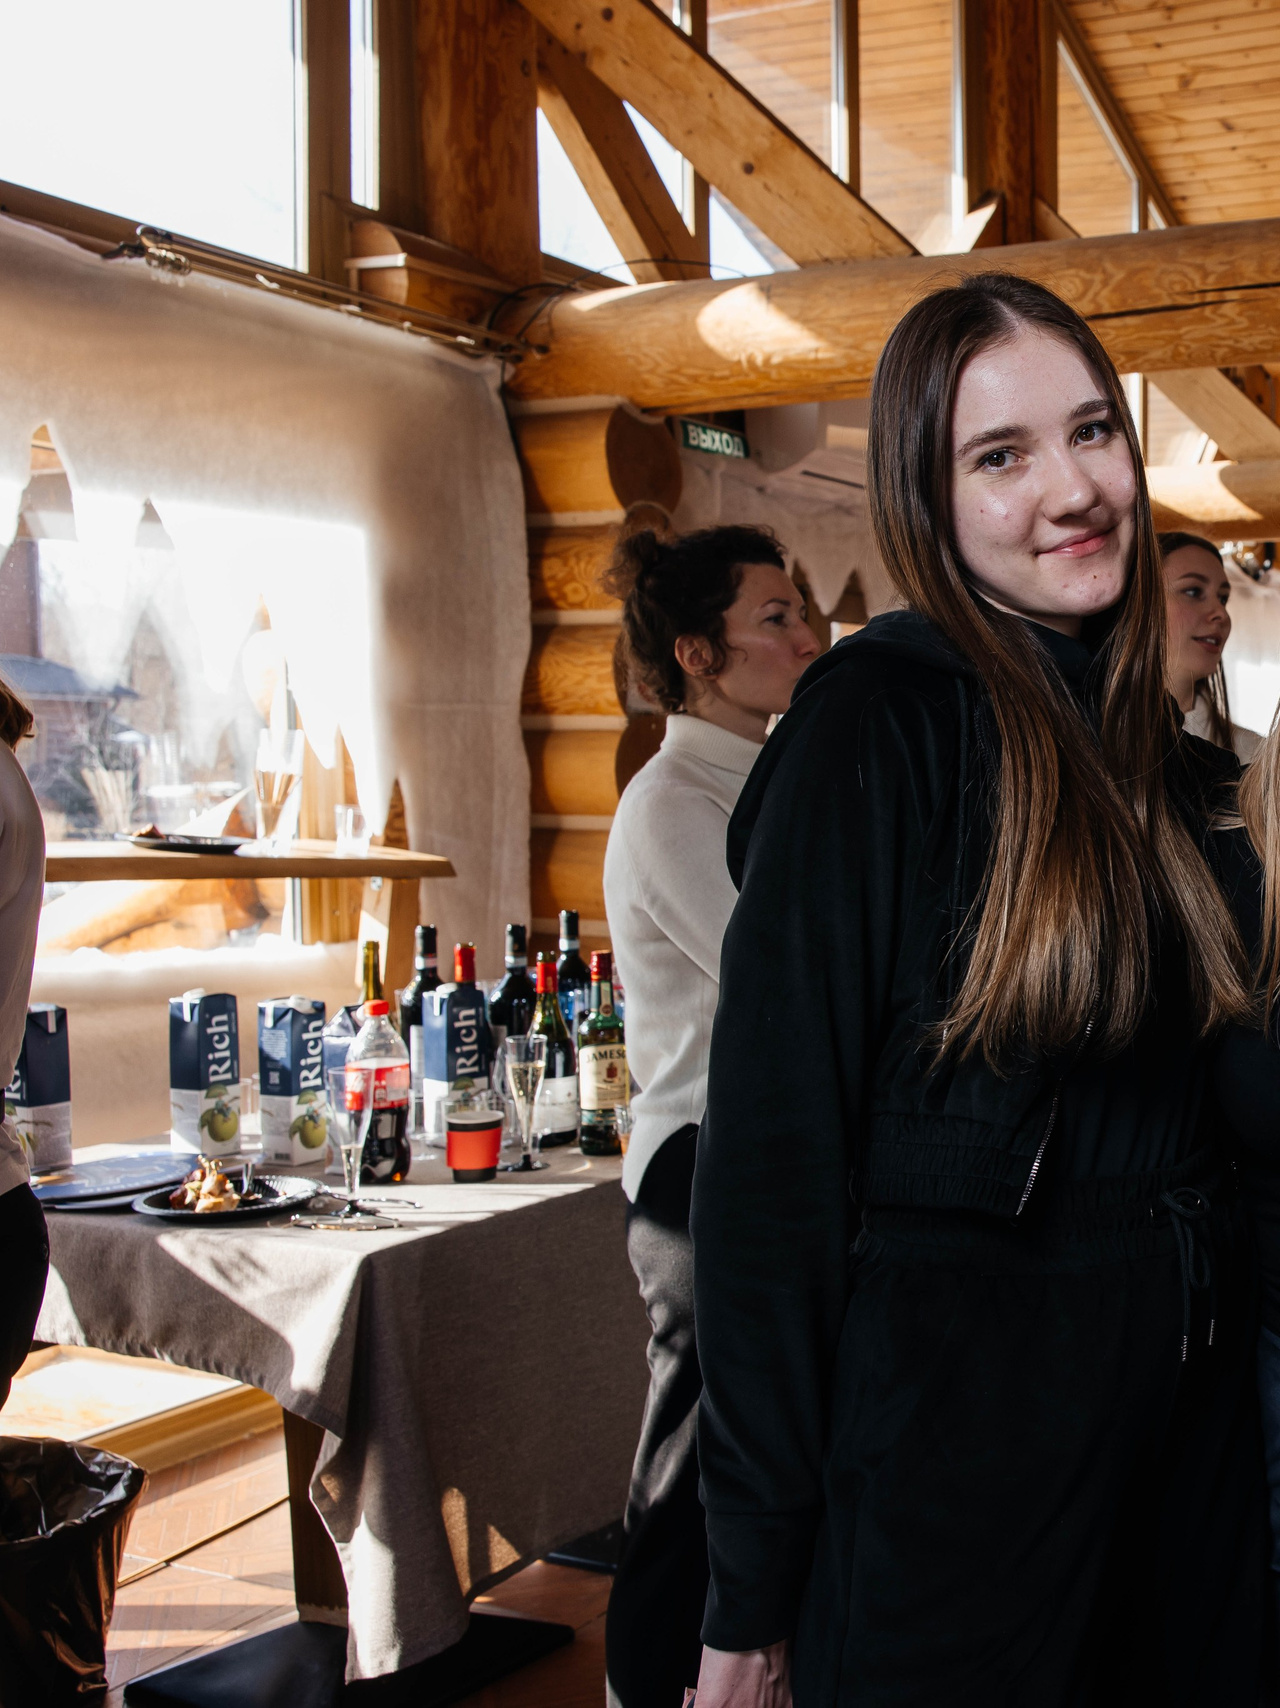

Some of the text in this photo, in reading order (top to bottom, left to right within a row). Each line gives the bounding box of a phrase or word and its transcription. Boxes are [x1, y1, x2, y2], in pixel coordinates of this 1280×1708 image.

[687, 424, 744, 457] ВЫХОД
[205, 1014, 232, 1083] Rich
[299, 1019, 324, 1089] Rich
[453, 1008, 479, 1076] Rich
